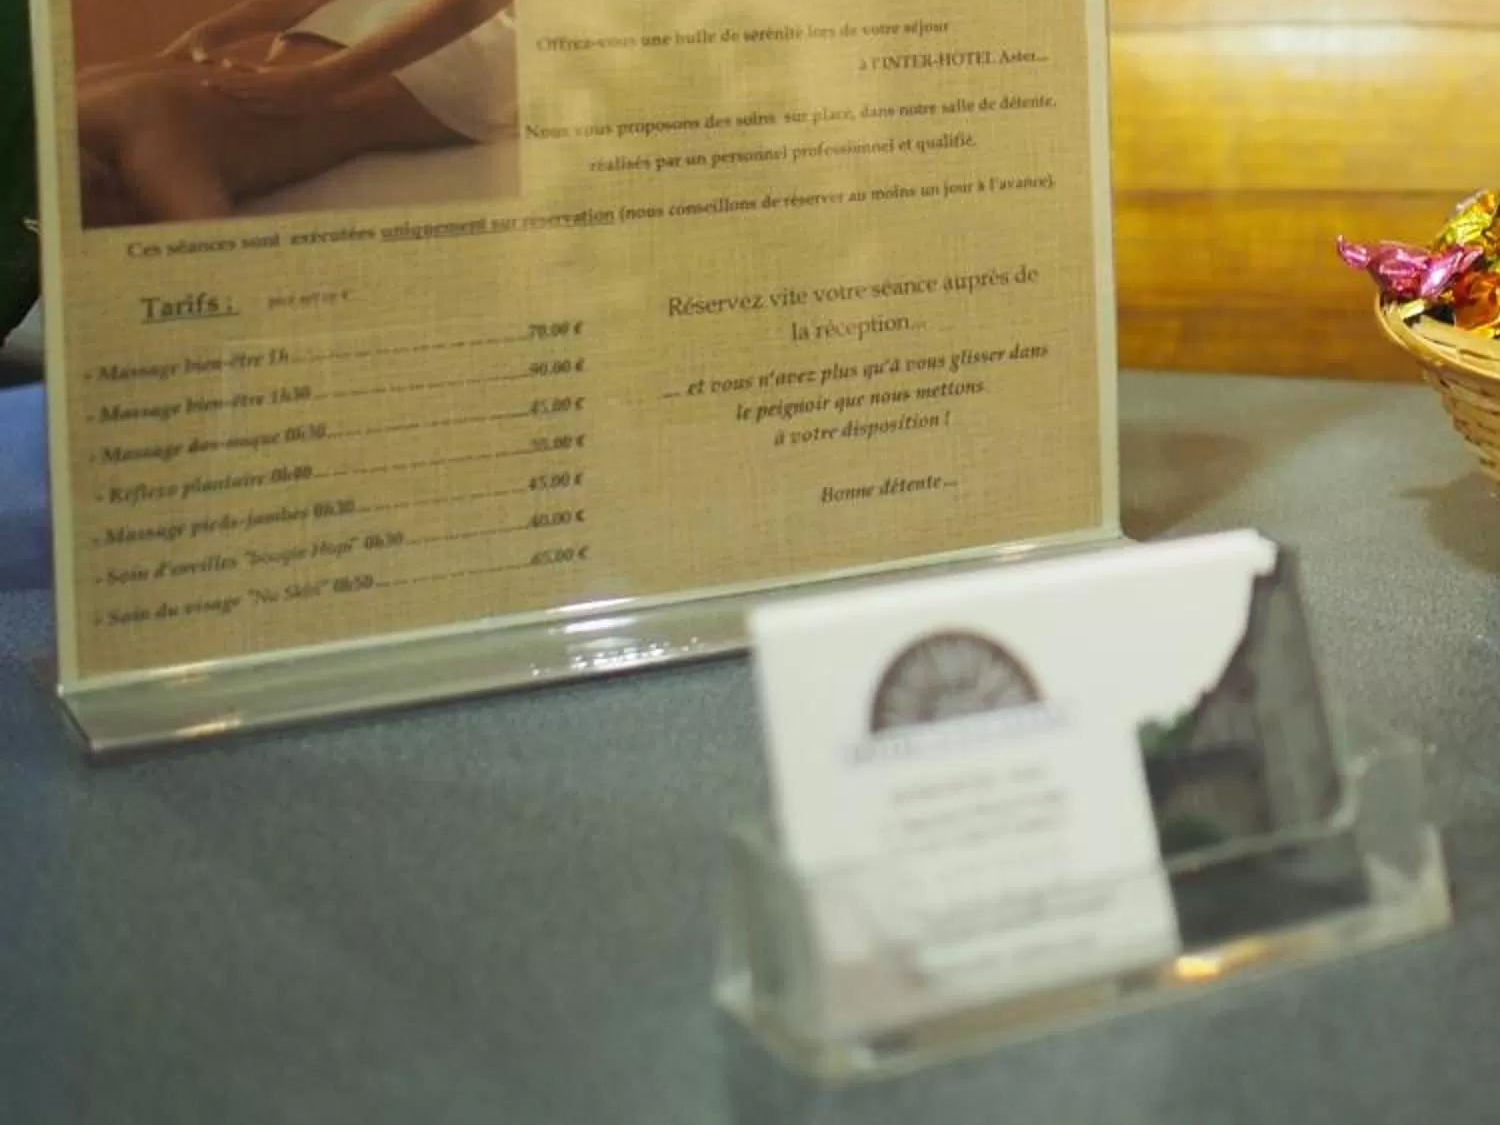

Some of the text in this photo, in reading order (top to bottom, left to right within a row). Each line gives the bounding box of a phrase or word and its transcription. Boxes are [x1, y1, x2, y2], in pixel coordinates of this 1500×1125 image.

[655, 155, 681, 172] par
[710, 145, 788, 170] personnel
[667, 263, 1038, 318] Réservez vite votre séance auprès de
[140, 291, 220, 320] Tarifs
[790, 321, 809, 343] la
[687, 377, 705, 396] et
[710, 375, 753, 393] vous
[819, 361, 858, 387] plus
[949, 348, 1006, 374] glisser
[915, 380, 984, 400] mettons
[841, 412, 939, 440] disposition
[821, 484, 875, 504] Bonne
